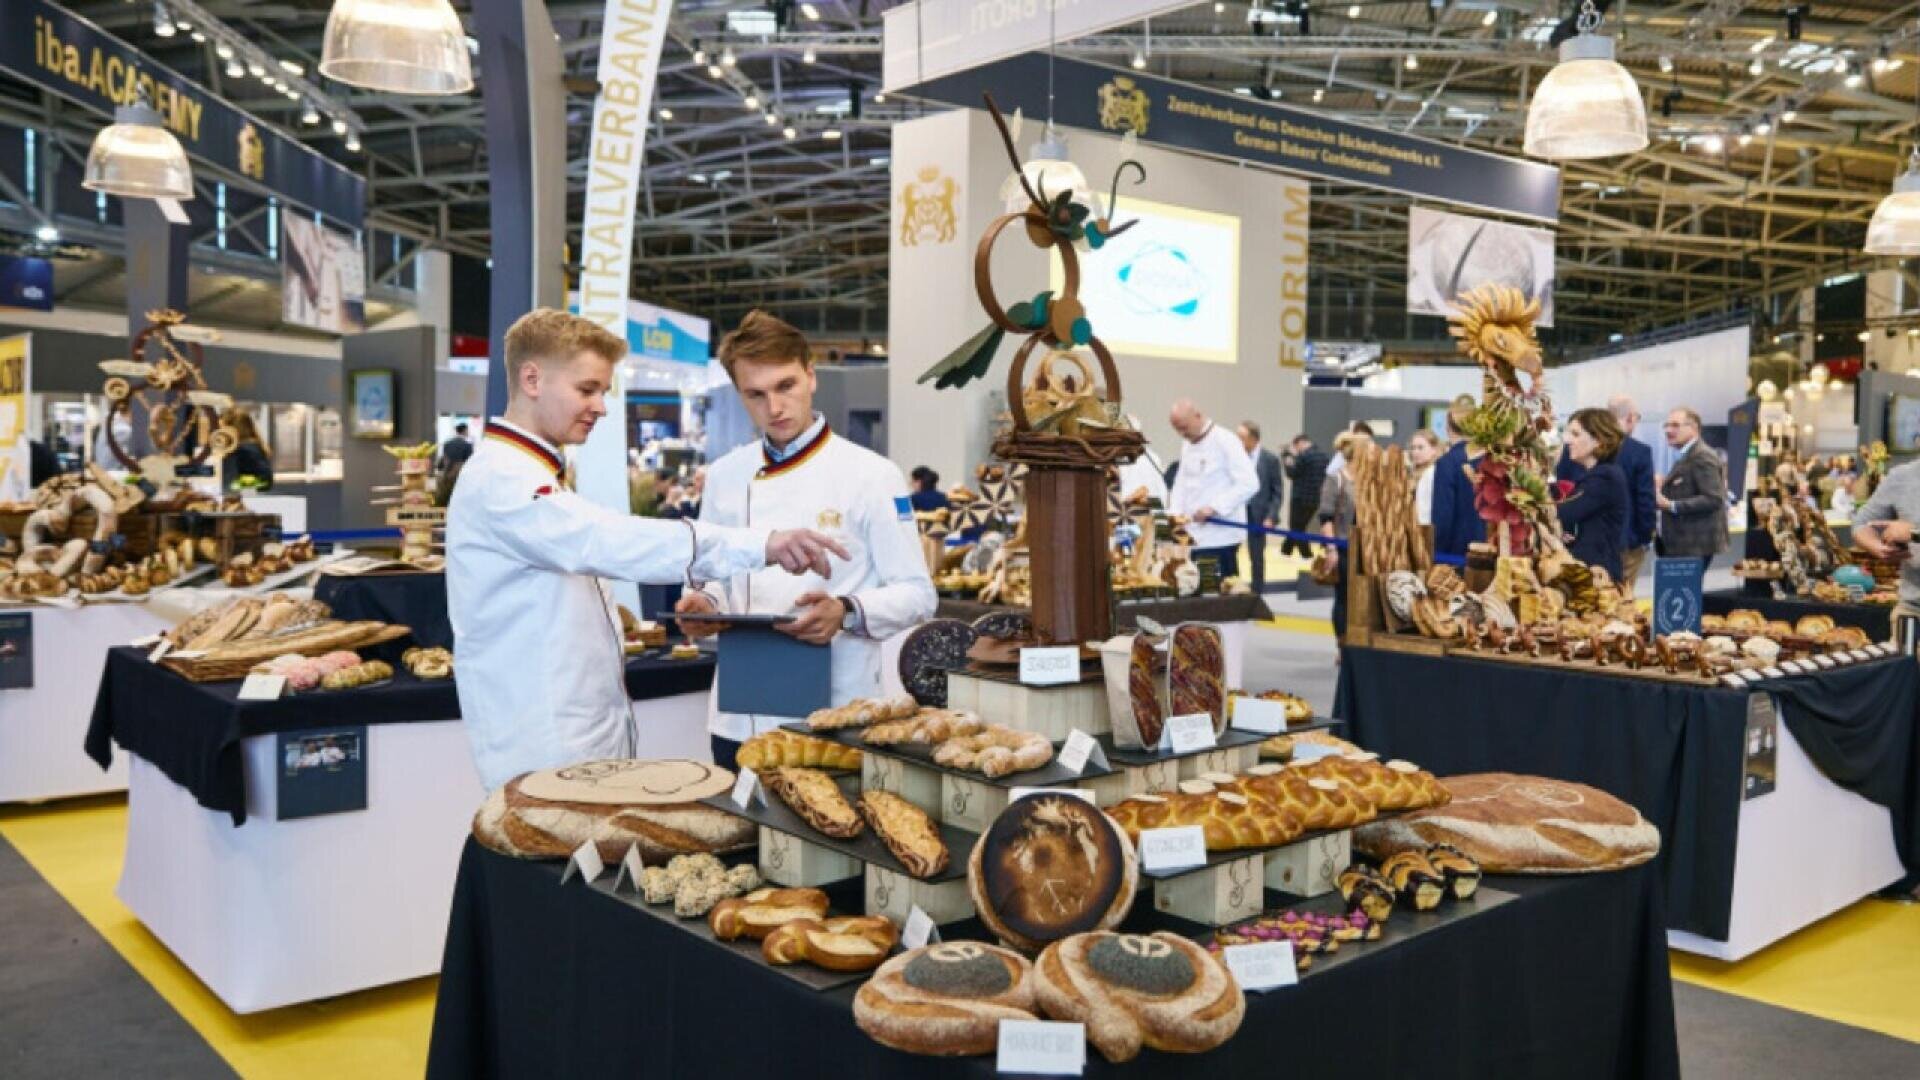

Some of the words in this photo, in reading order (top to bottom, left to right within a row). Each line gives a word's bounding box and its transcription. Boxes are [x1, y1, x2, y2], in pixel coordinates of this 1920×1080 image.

[1168, 95, 1257, 127] Zentralverband
[1258, 116, 1279, 133] des
[1281, 119, 1336, 145] Deutschen
[1338, 131, 1424, 165] Bäckerhandwerks
[1234, 129, 1279, 153] German
[1322, 149, 1392, 176] Confederation
[1279, 185, 1311, 370] FORUM
[1671, 596, 1684, 620] 2
